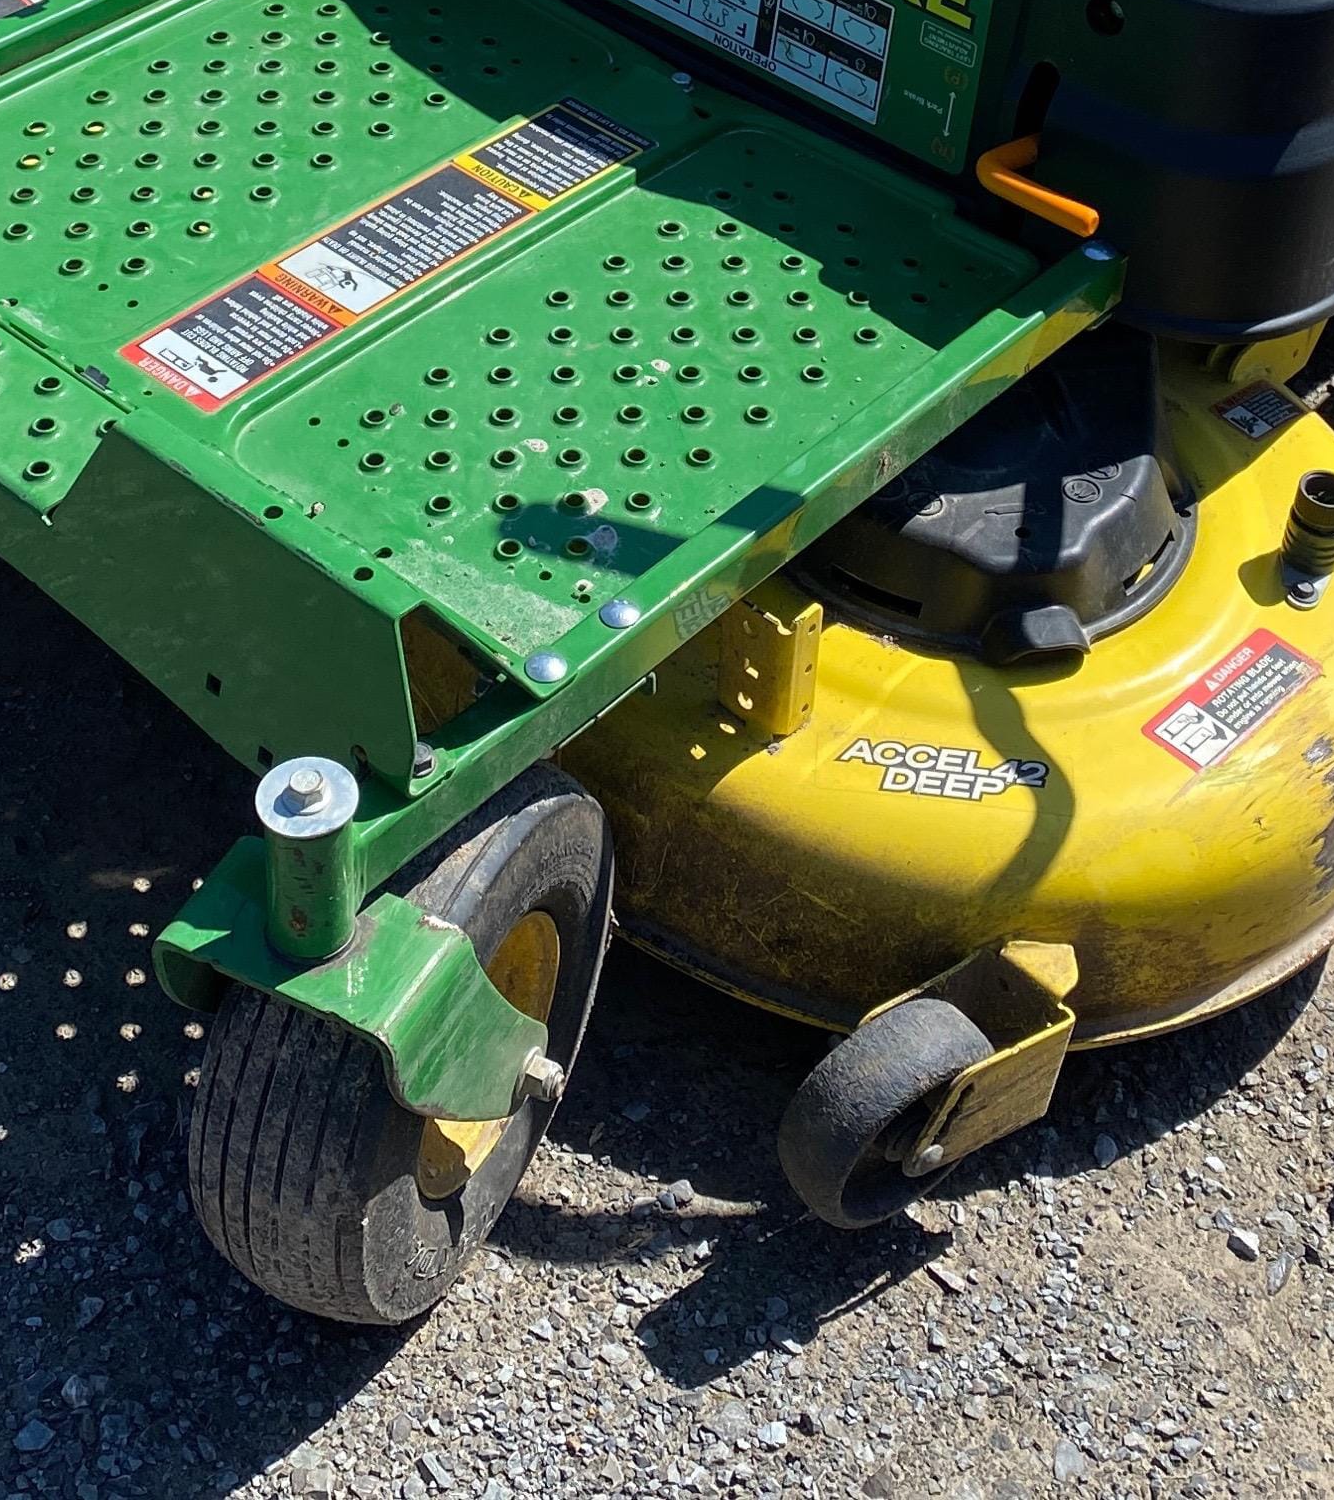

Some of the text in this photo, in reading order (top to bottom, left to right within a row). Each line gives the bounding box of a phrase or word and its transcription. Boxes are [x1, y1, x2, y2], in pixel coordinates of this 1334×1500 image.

[735, 23, 747, 38] F
[714, 34, 776, 71] OPERATION
[473, 166, 519, 192] CAUTION
[276, 275, 328, 308] WARNING
[181, 329, 248, 373] ROTATING BLADES CUT
[193, 326, 254, 365] OFF ARMS AND LEGS
[139, 358, 188, 389] DANGER
[1213, 655, 1273, 707] ROTATING BLADE
[1214, 648, 1253, 681] DANGER
[1217, 709, 1228, 718] Do
[1227, 699, 1239, 710] not
[1237, 690, 1250, 702] put
[1247, 676, 1267, 692] hands
[1271, 659, 1286, 670] feet
[1226, 707, 1244, 723] under
[1250, 691, 1263, 702] into
[1263, 675, 1283, 692] mower
[1234, 711, 1255, 729] engine
[837, 738, 1050, 788] ACCEL 42
[879, 766, 1007, 802] DEEP
